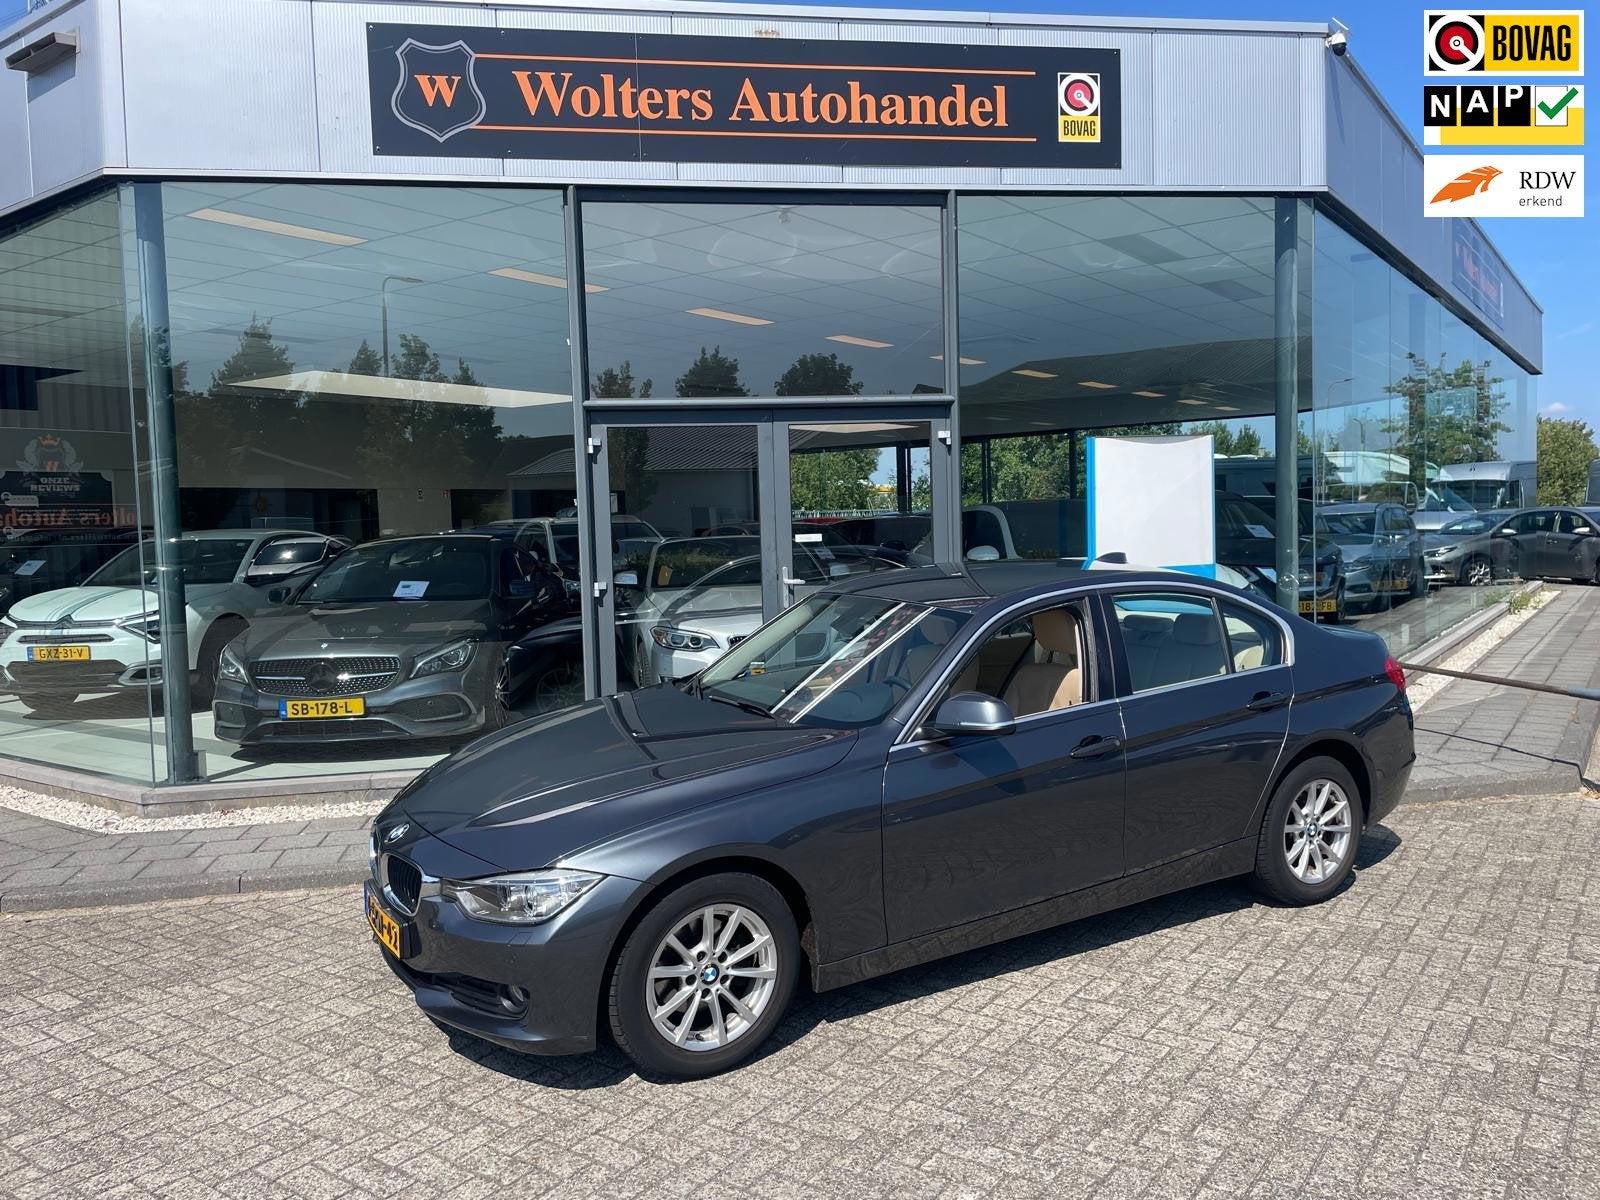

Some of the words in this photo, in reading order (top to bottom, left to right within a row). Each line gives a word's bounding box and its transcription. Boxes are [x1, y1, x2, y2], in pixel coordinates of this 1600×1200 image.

[414, 74, 462, 108] W
[511, 70, 714, 121] Wolters
[729, 77, 1009, 127] Autohandel
[1063, 120, 1096, 137] BOVAG
[39, 648, 83, 659] GXZ-31-V
[291, 701, 353, 716] SB-178-L
